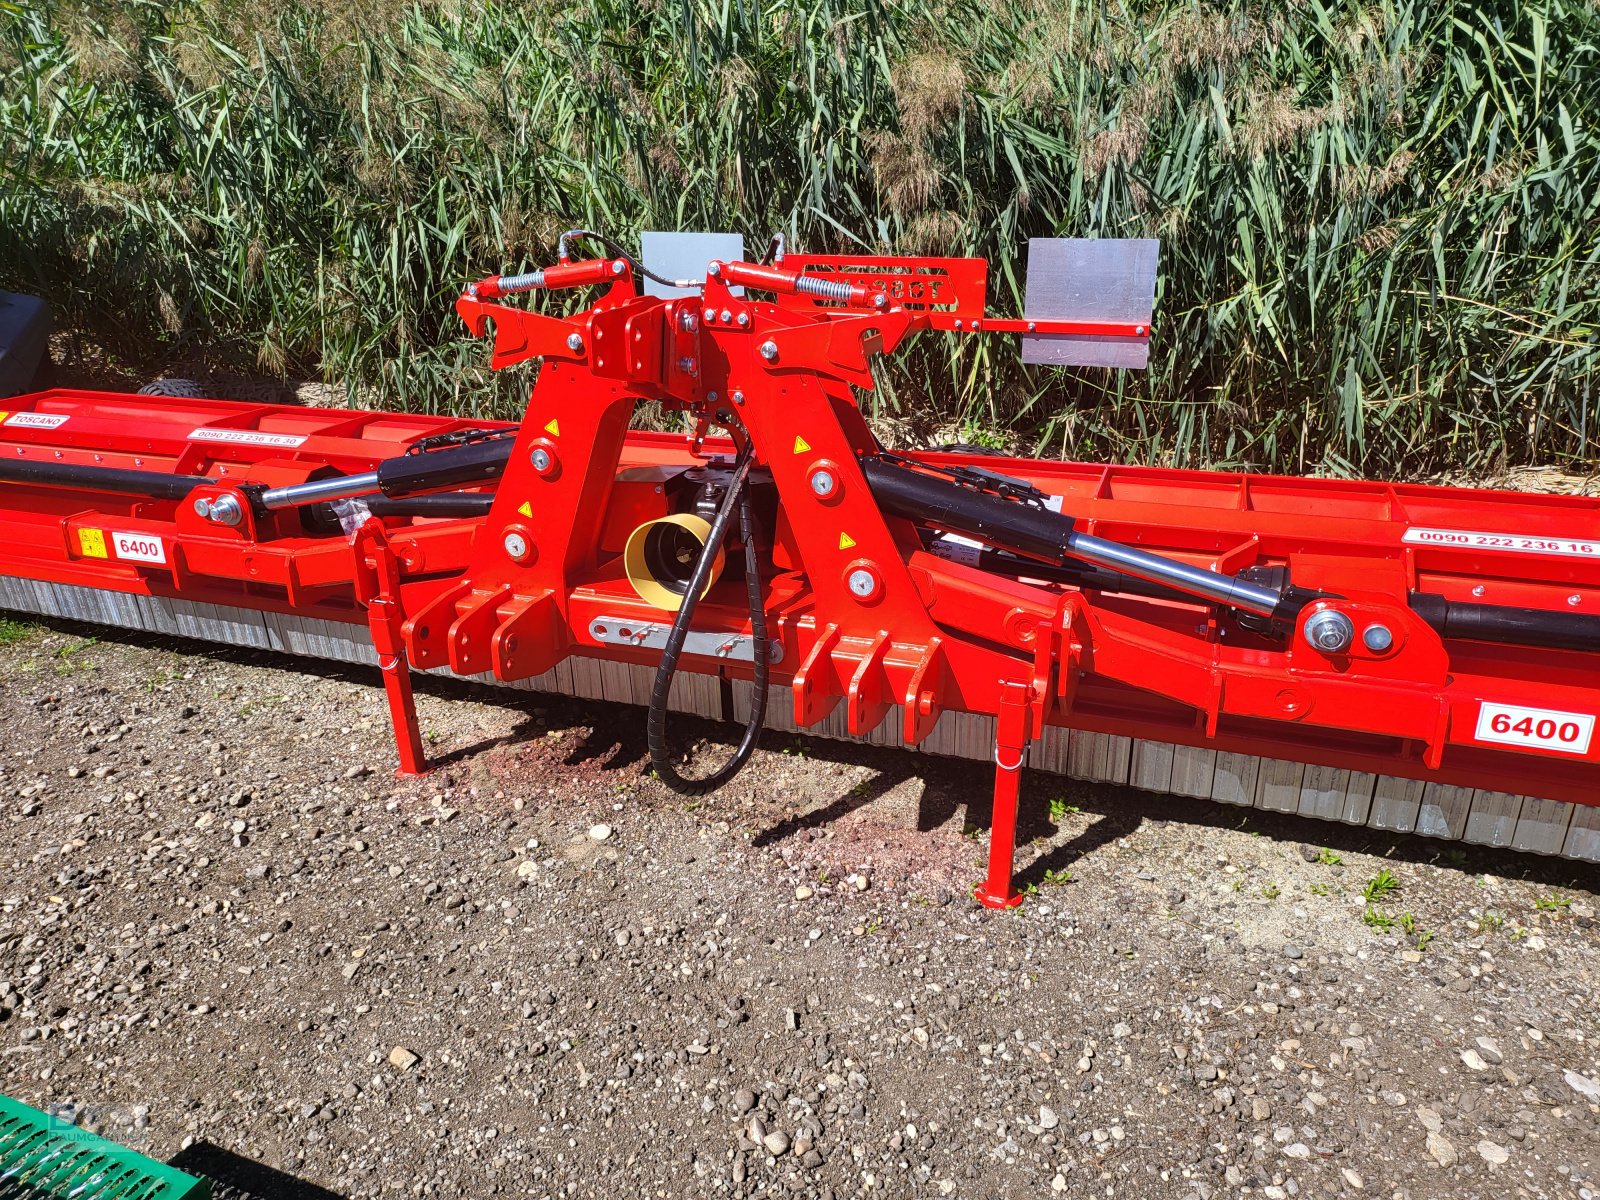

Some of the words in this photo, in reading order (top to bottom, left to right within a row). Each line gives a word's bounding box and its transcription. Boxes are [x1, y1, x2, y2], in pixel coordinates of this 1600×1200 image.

[14, 415, 61, 425] TOSCANO
[246, 434, 264, 442] 236
[120, 539, 158, 556] 6400
[1419, 532, 1469, 543] 0090
[1476, 536, 1514, 547] 222
[1521, 539, 1560, 550] 236
[1568, 543, 1593, 553] 16
[1491, 713, 1580, 743] 6400
